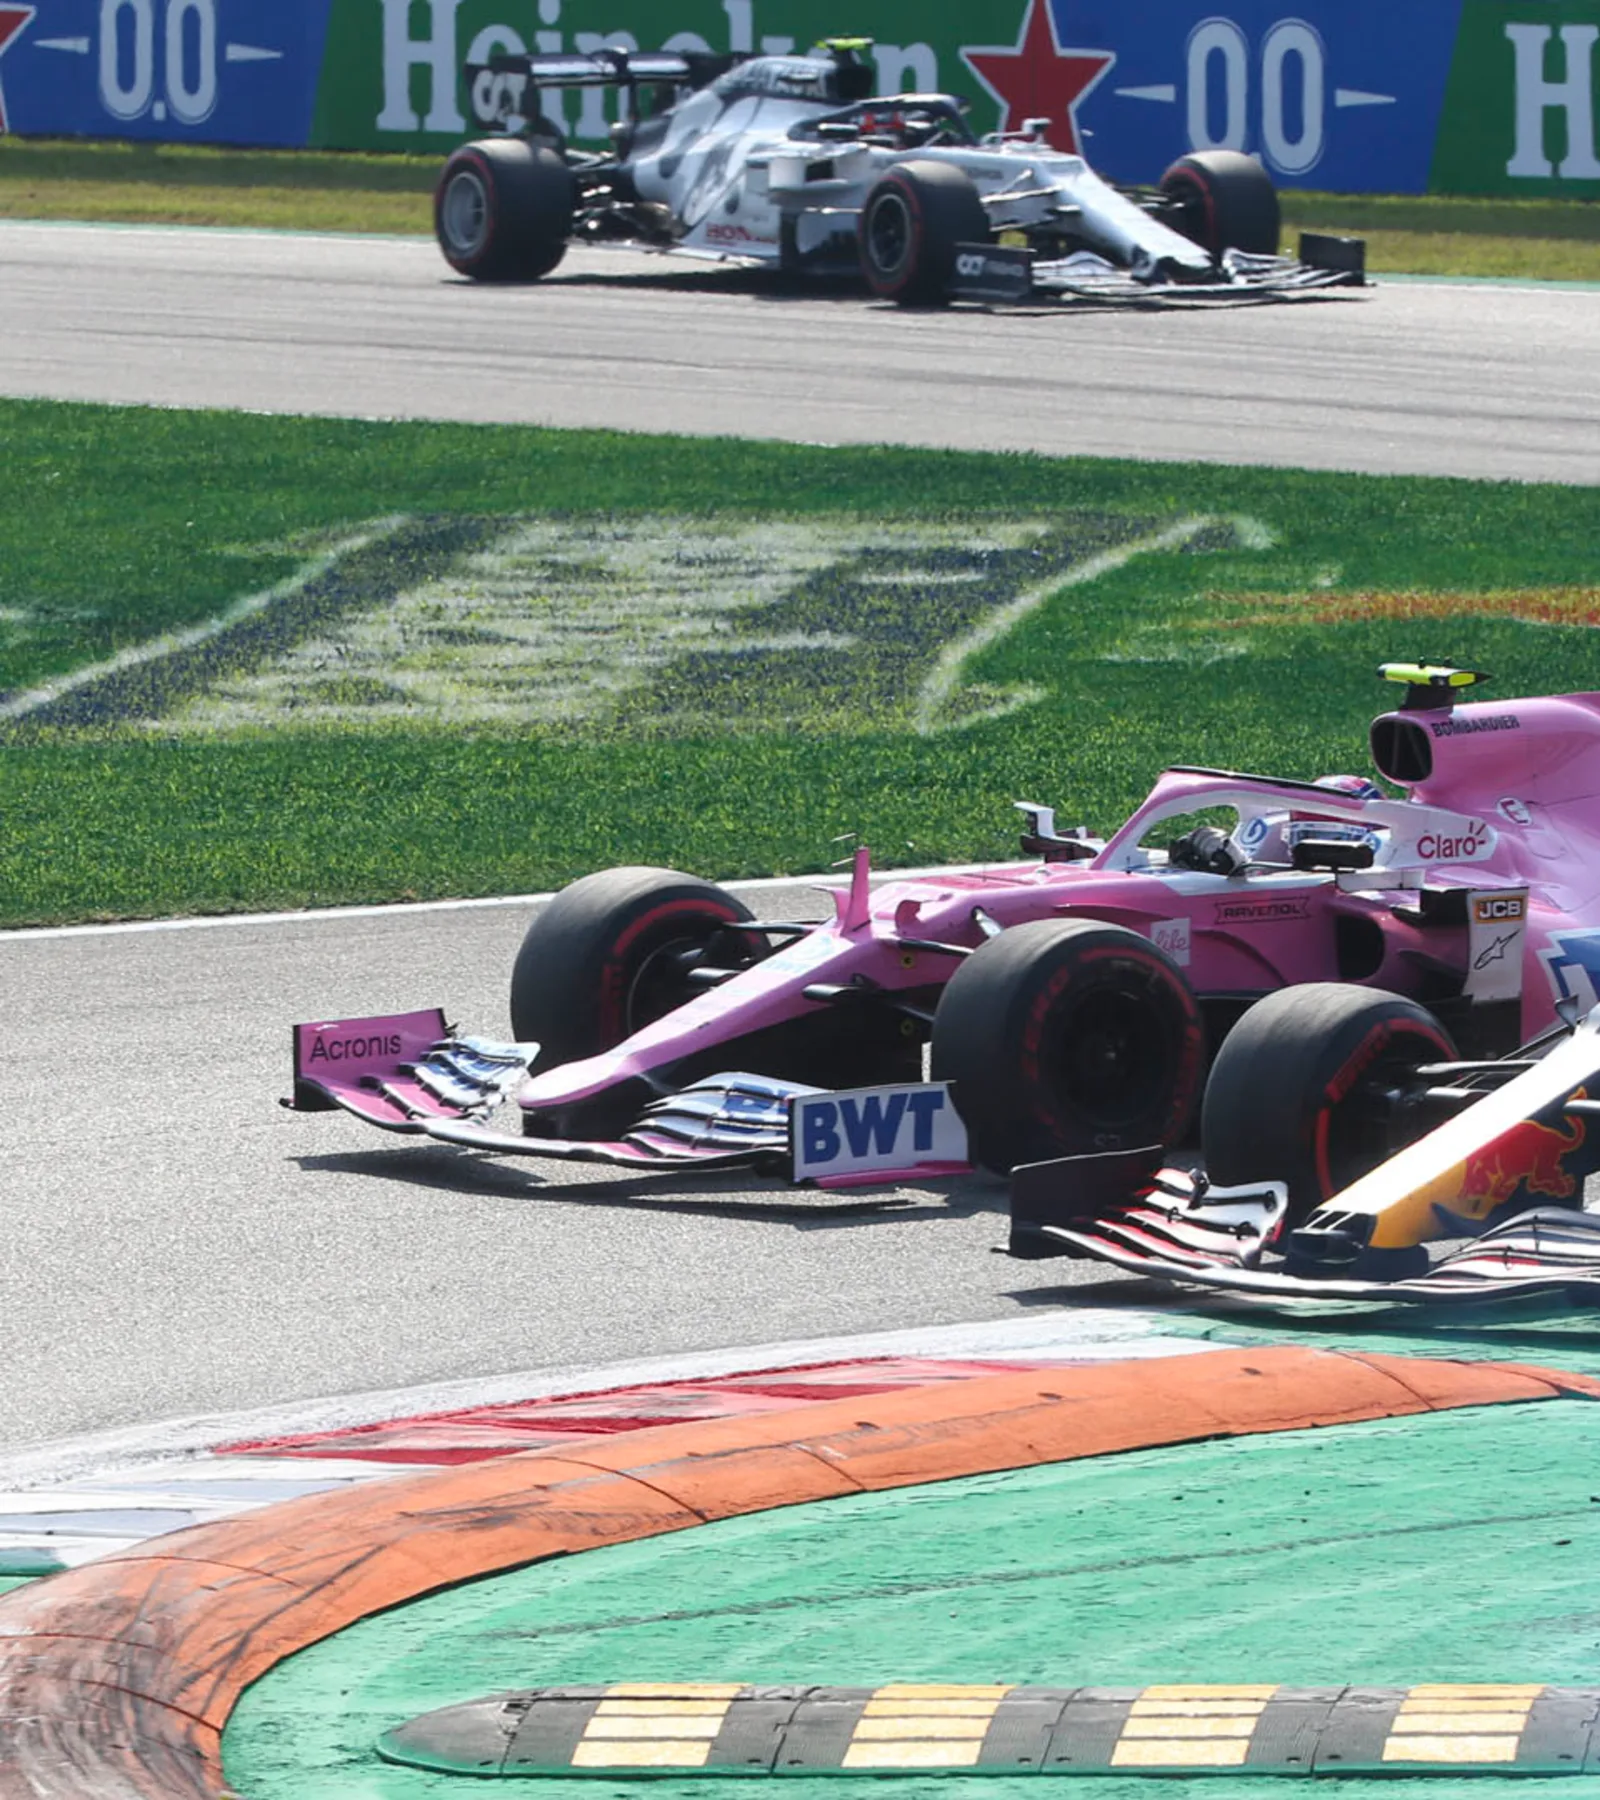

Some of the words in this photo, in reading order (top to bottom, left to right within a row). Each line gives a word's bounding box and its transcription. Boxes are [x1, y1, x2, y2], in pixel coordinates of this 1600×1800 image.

[1431, 714, 1521, 738] BOMBARDIER
[1417, 834, 1476, 860] Claro
[1224, 903, 1301, 918] RAVENOL
[1479, 900, 1522, 920] JCB
[309, 1031, 401, 1063] Acronis
[803, 1100, 943, 1164] BWT
